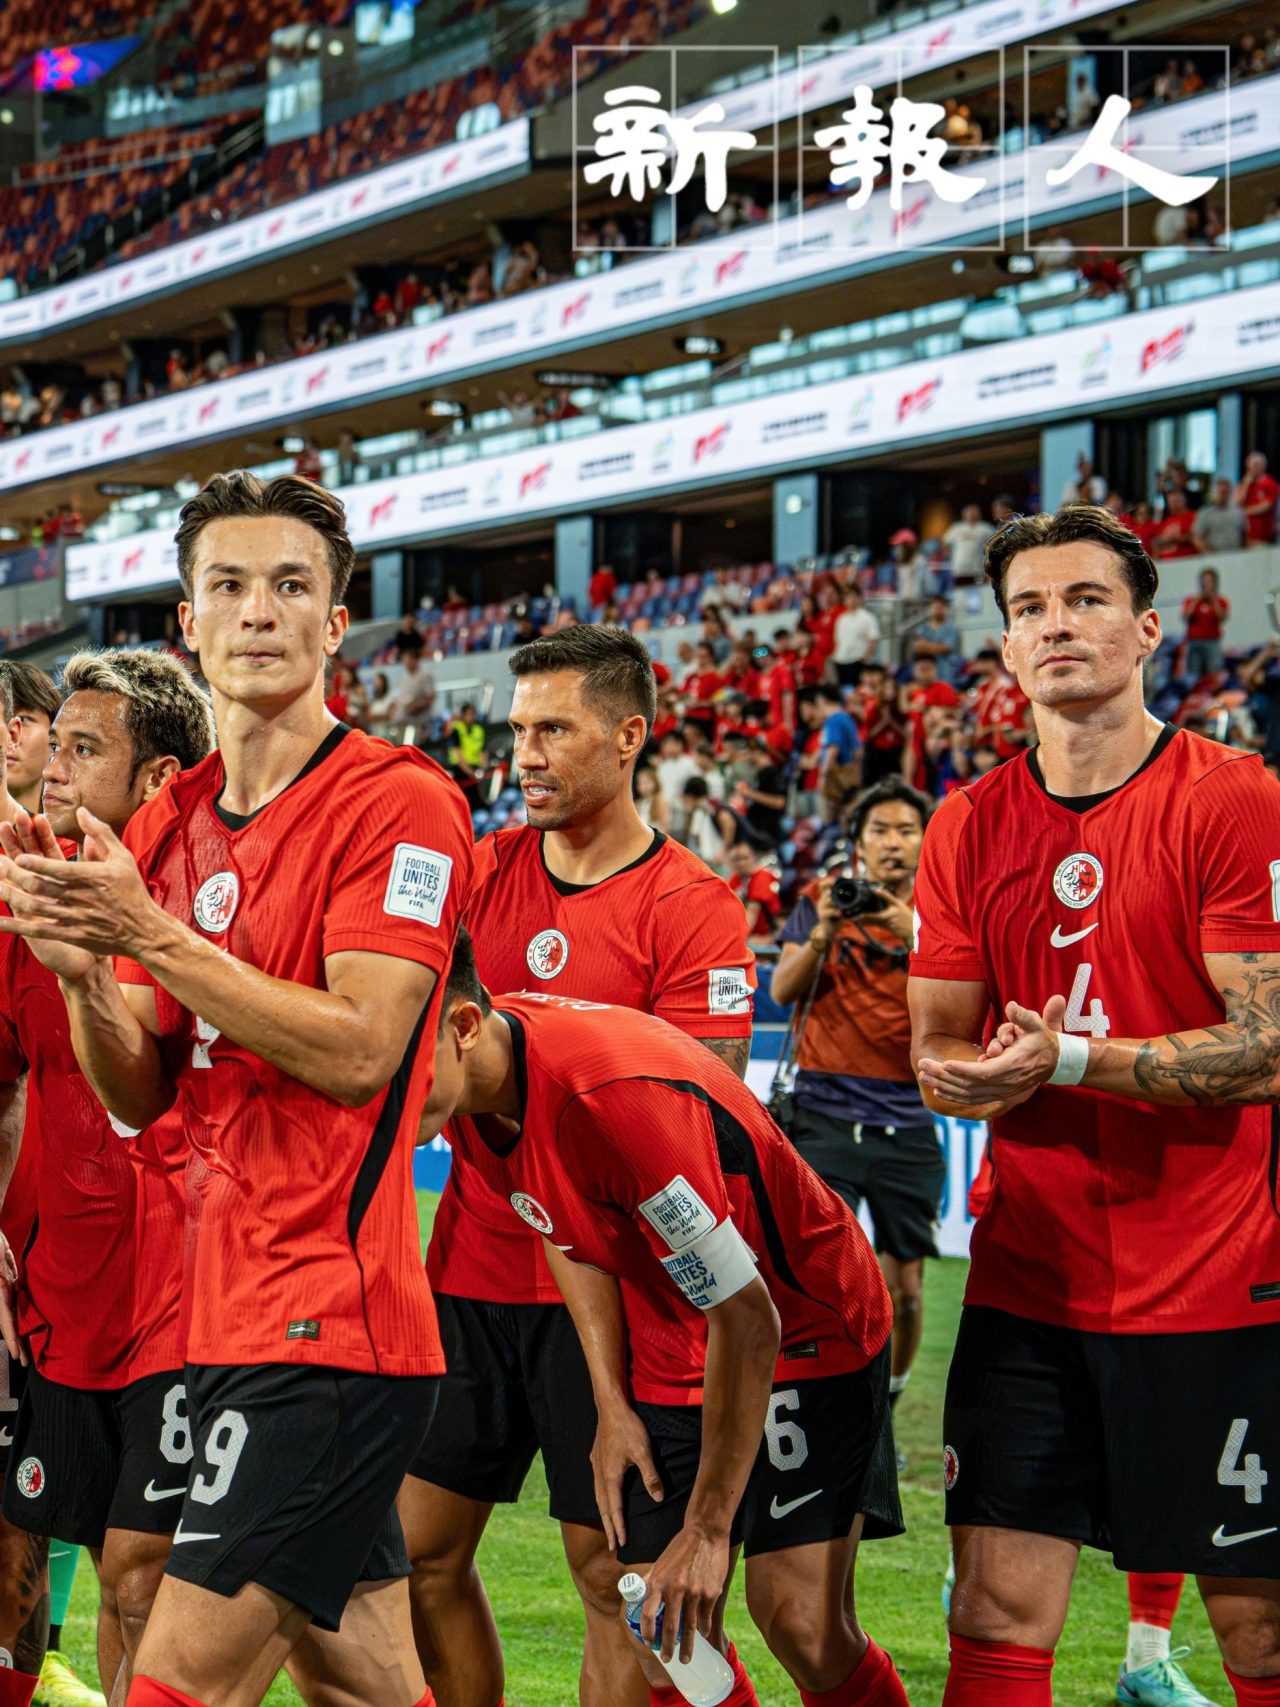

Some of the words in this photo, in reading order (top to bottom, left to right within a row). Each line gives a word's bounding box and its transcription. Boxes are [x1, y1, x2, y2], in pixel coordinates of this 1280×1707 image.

[403, 868, 440, 891] UNITES
[406, 858, 441, 876] FOOTBALL
[398, 884, 413, 896] the
[409, 900, 424, 909] FIFA
[719, 984, 749, 996] UNITES
[1064, 963, 1111, 1037] 4
[653, 1190, 685, 1216] FOOTBALL
[658, 1197, 693, 1226] UNITES
[666, 1224, 681, 1236] the
[680, 1206, 702, 1229] World
[682, 1225, 697, 1237] FIFA
[663, 1250, 701, 1272] OTBALL
[159, 1384, 194, 1464] 8
[765, 1389, 808, 1471] 6
[190, 1409, 249, 1506] 9
[1217, 1418, 1268, 1504] 4
